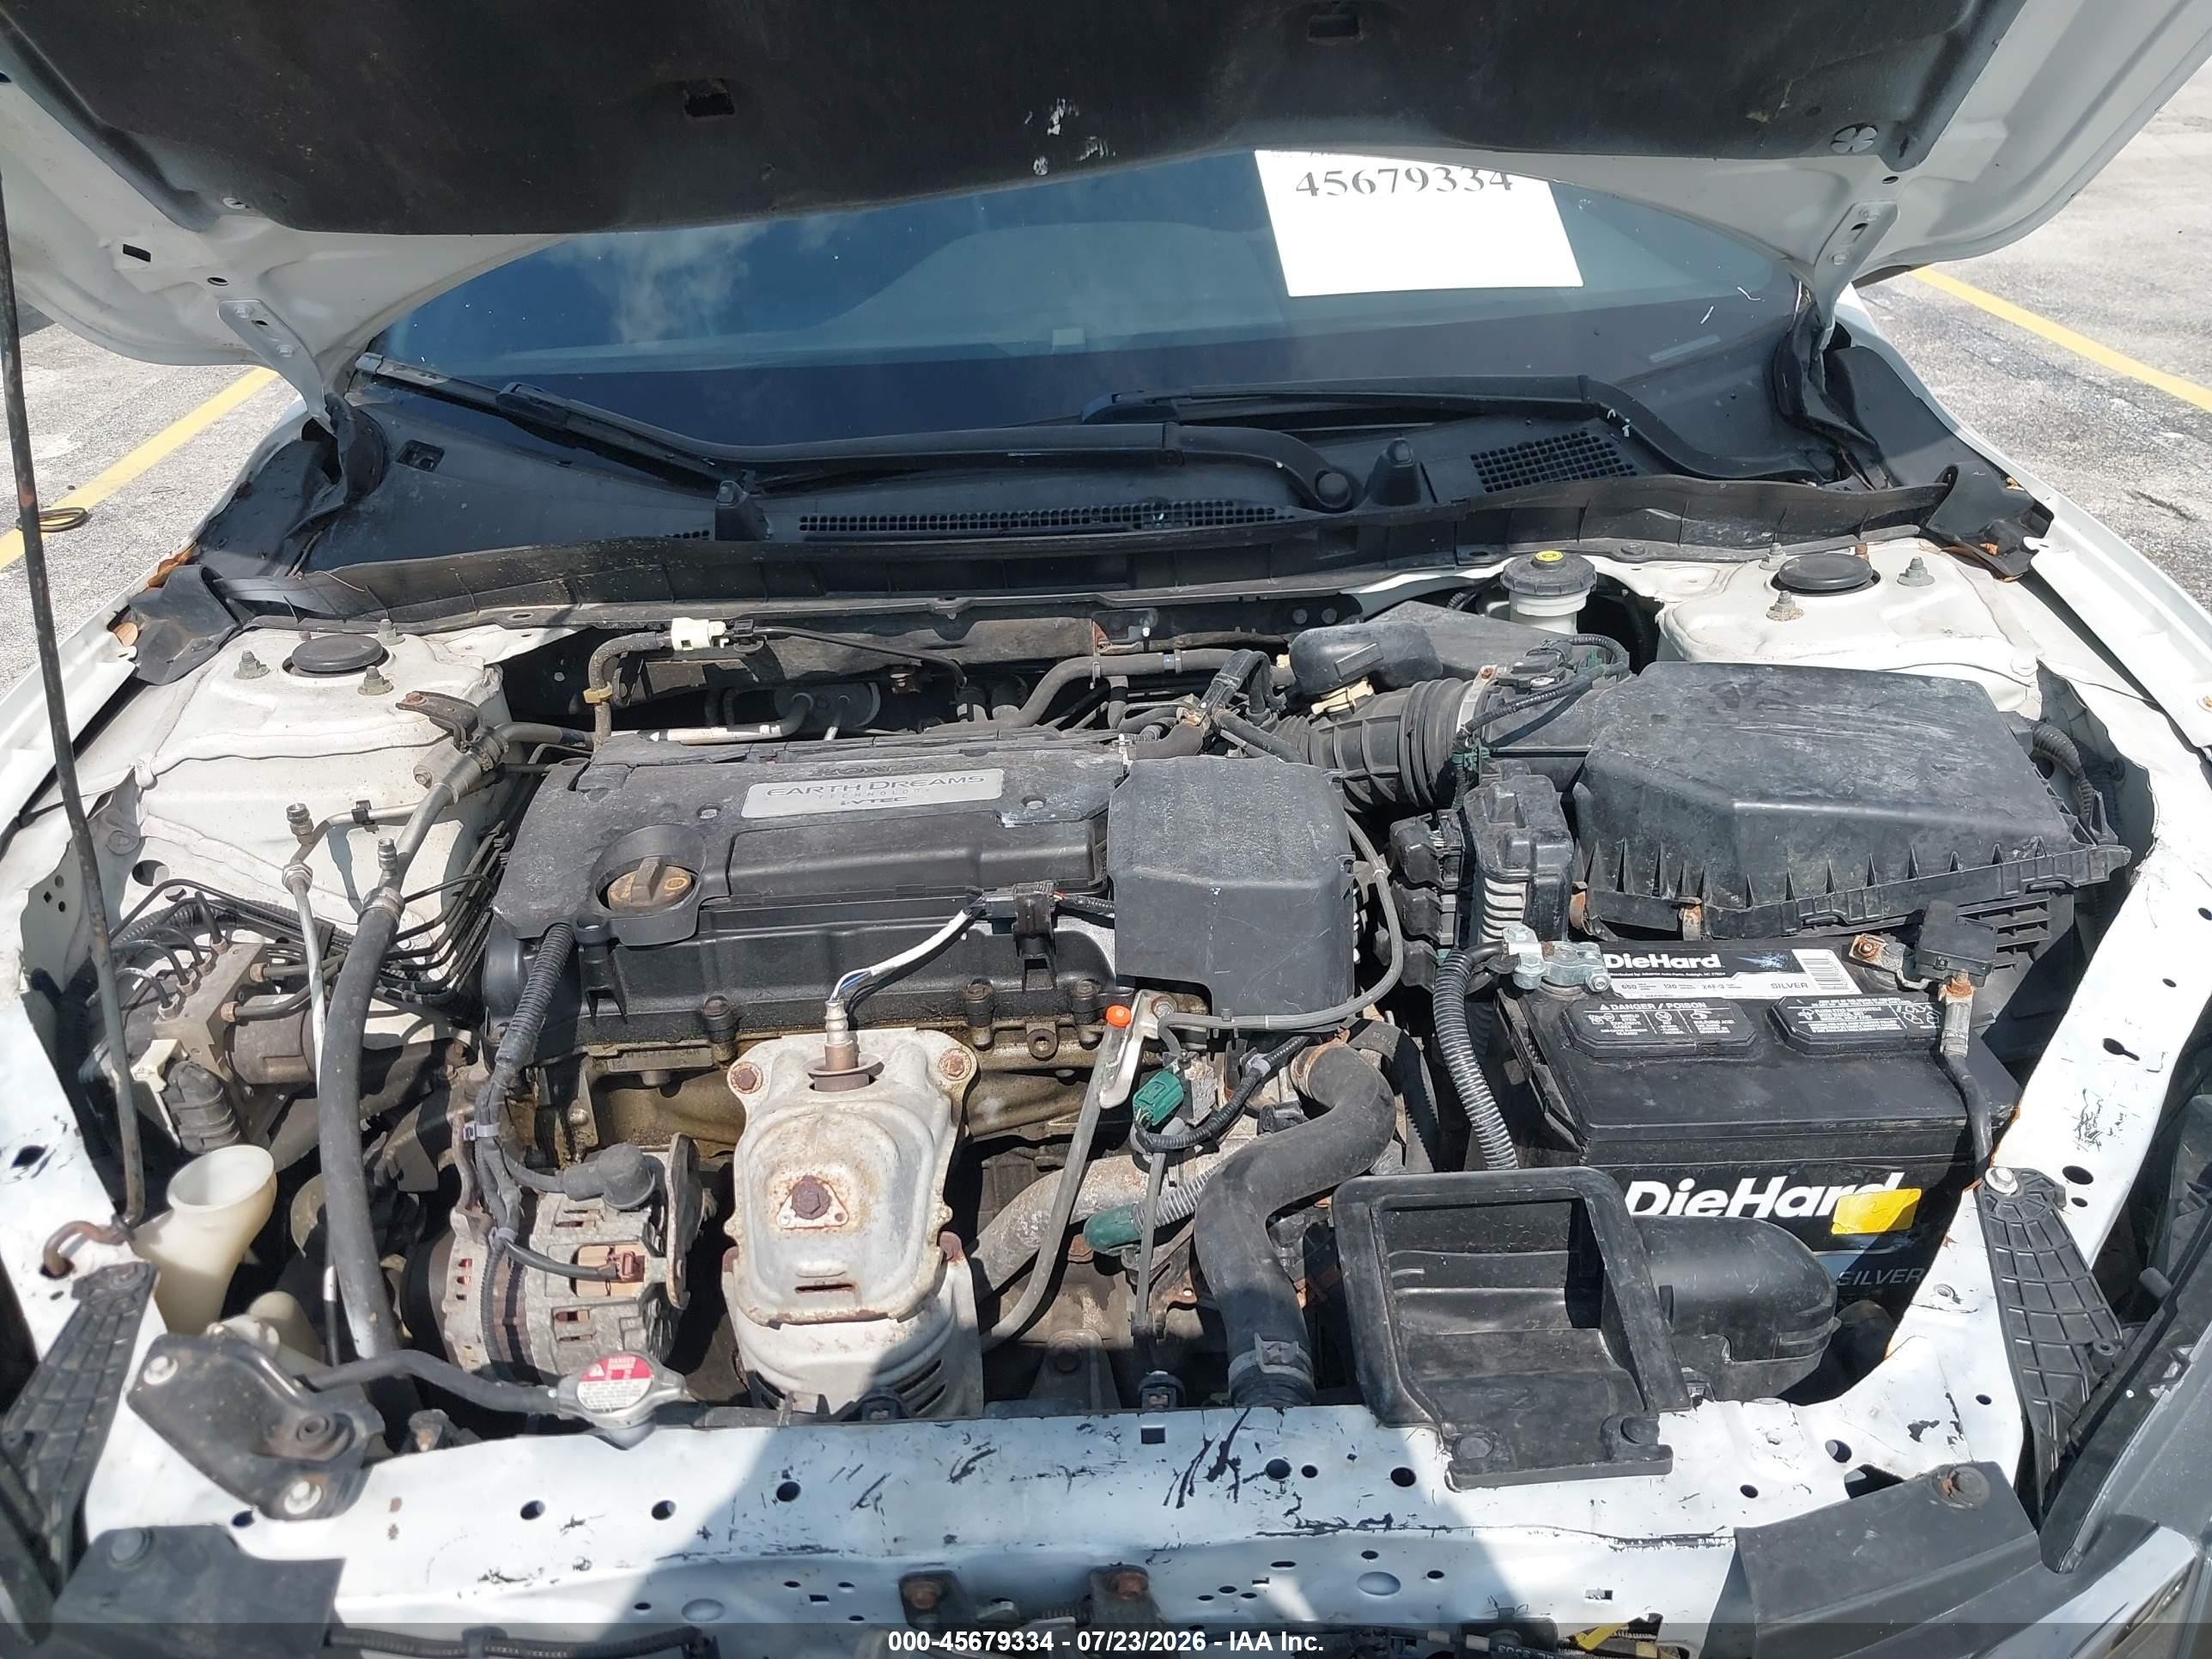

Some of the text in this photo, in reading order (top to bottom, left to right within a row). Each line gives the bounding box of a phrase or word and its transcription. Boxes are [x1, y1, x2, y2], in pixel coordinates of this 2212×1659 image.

[1296, 167, 1513, 197] 45679334
[767, 775, 985, 796] EARTH DREAMS
[1602, 952, 1723, 969] DieHard
[1837, 1267, 1925, 1287] SILVER
